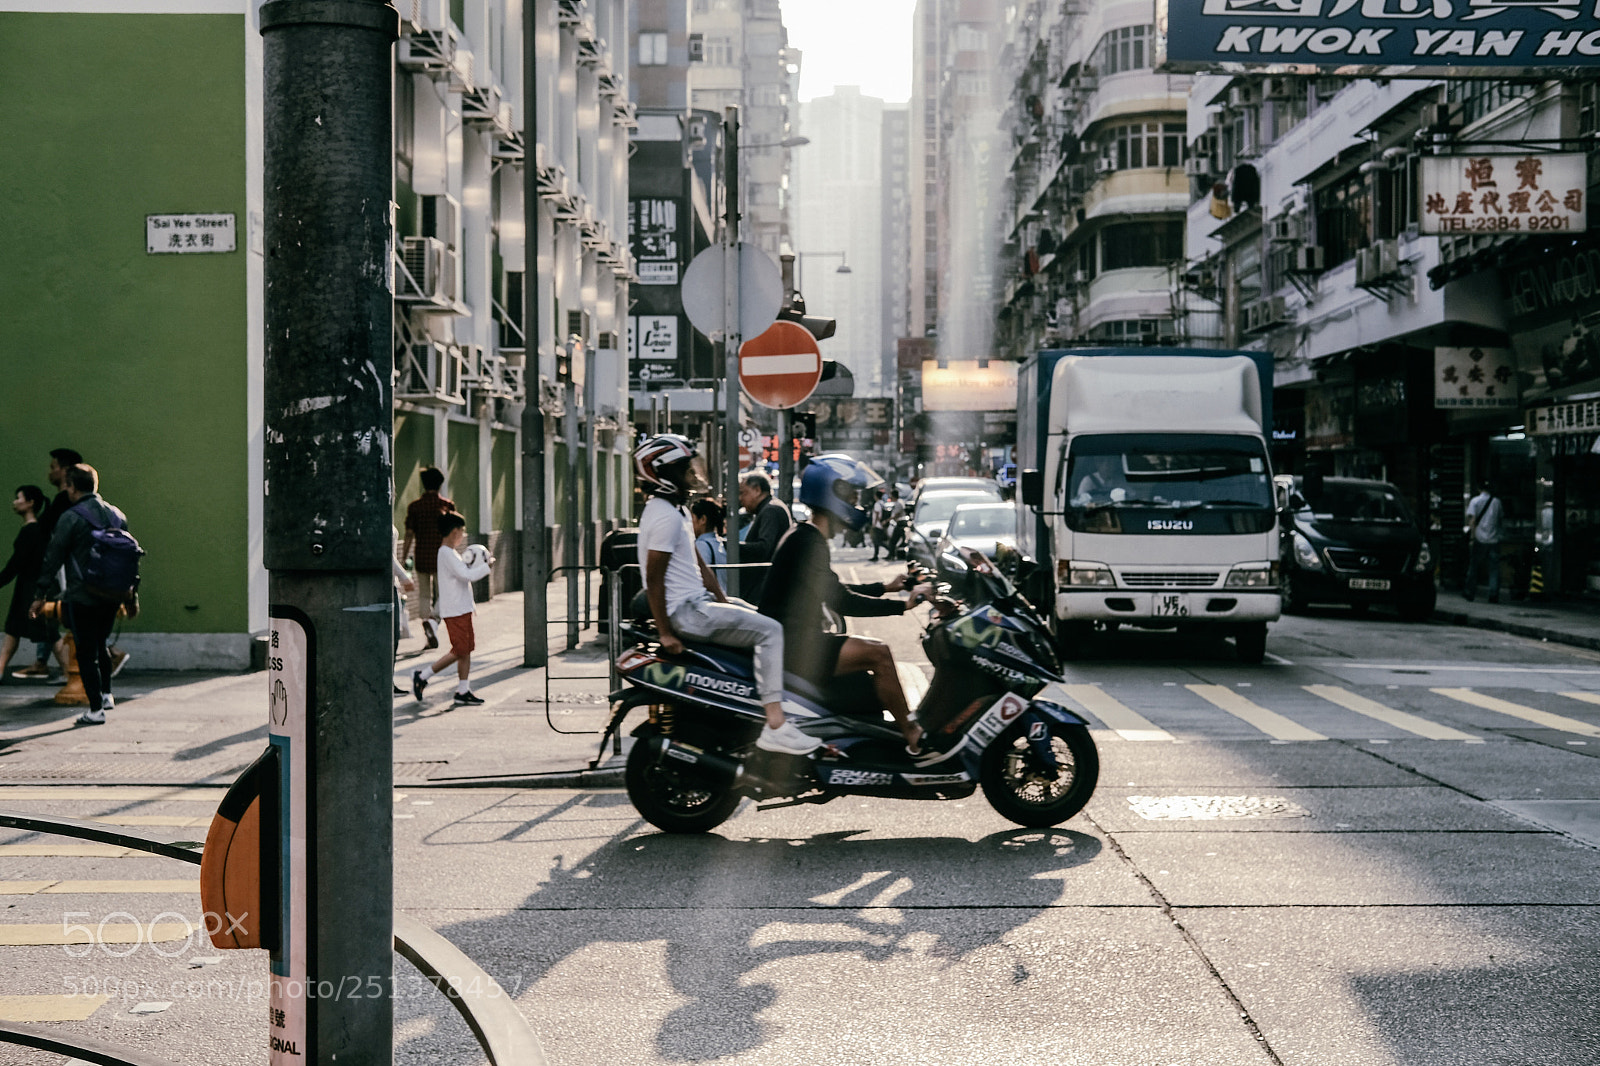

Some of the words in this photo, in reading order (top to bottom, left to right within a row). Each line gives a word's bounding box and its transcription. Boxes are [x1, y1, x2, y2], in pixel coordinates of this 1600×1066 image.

[1216, 26, 1395, 55] KWOK
[1412, 29, 1525, 56] YAN
[153, 218, 170, 229] Sai
[173, 218, 192, 228] Yee
[195, 217, 228, 228] Street
[1439, 216, 1521, 231] TEL:2384
[1528, 215, 1570, 230] 9201
[168, 233, 215, 248] 洗衣街
[1147, 520, 1193, 530] ISUZU
[685, 672, 754, 696] movistar
